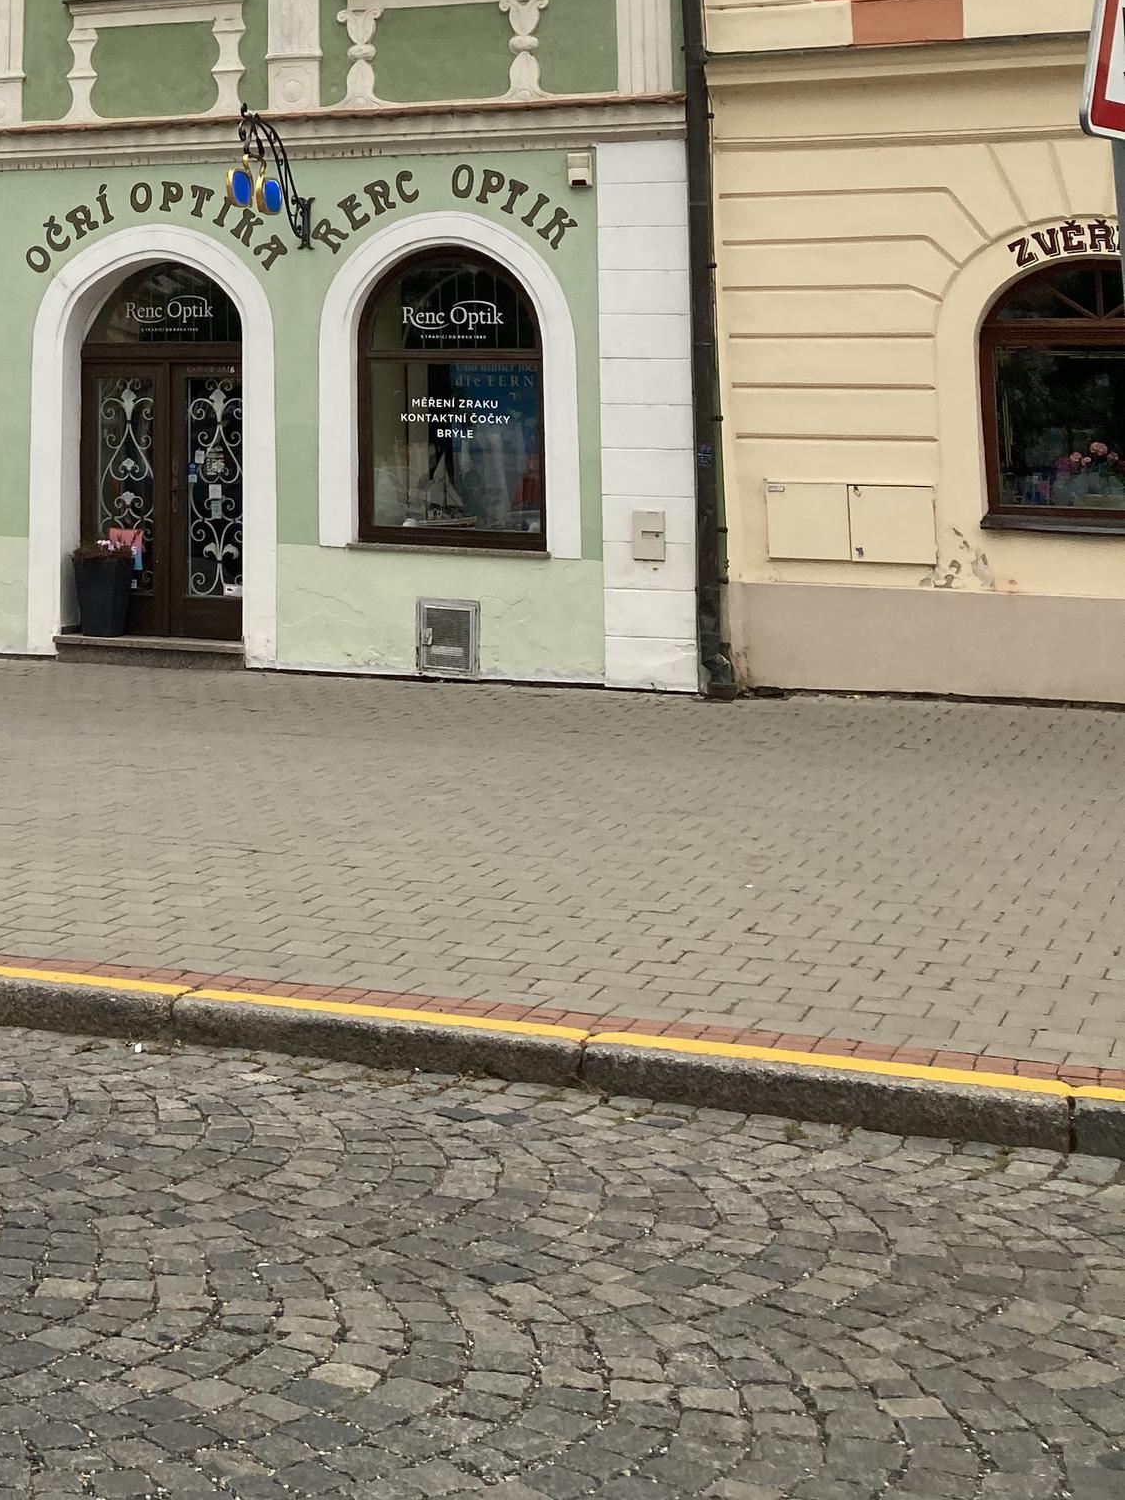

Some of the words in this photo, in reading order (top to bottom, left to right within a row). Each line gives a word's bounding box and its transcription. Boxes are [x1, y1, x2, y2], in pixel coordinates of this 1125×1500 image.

[311, 170, 419, 254] RENC
[451, 164, 578, 250] OPTIK
[26, 184, 114, 273] OČNÍ
[130, 181, 288, 271] OPTIKA
[1007, 219, 1120, 268] ZVĚŘ
[125, 301, 165, 324] Renc
[167, 295, 214, 324] Optik
[402, 306, 448, 330] Renc
[450, 300, 504, 330] Optik
[400, 409, 467, 423] KONTAKTNÍ
[470, 412, 511, 424] ČOČKY
[411, 397, 455, 408] MĚŘENÍ
[459, 399, 498, 409] ZRAKU
[437, 427, 474, 439] BRÝLE
